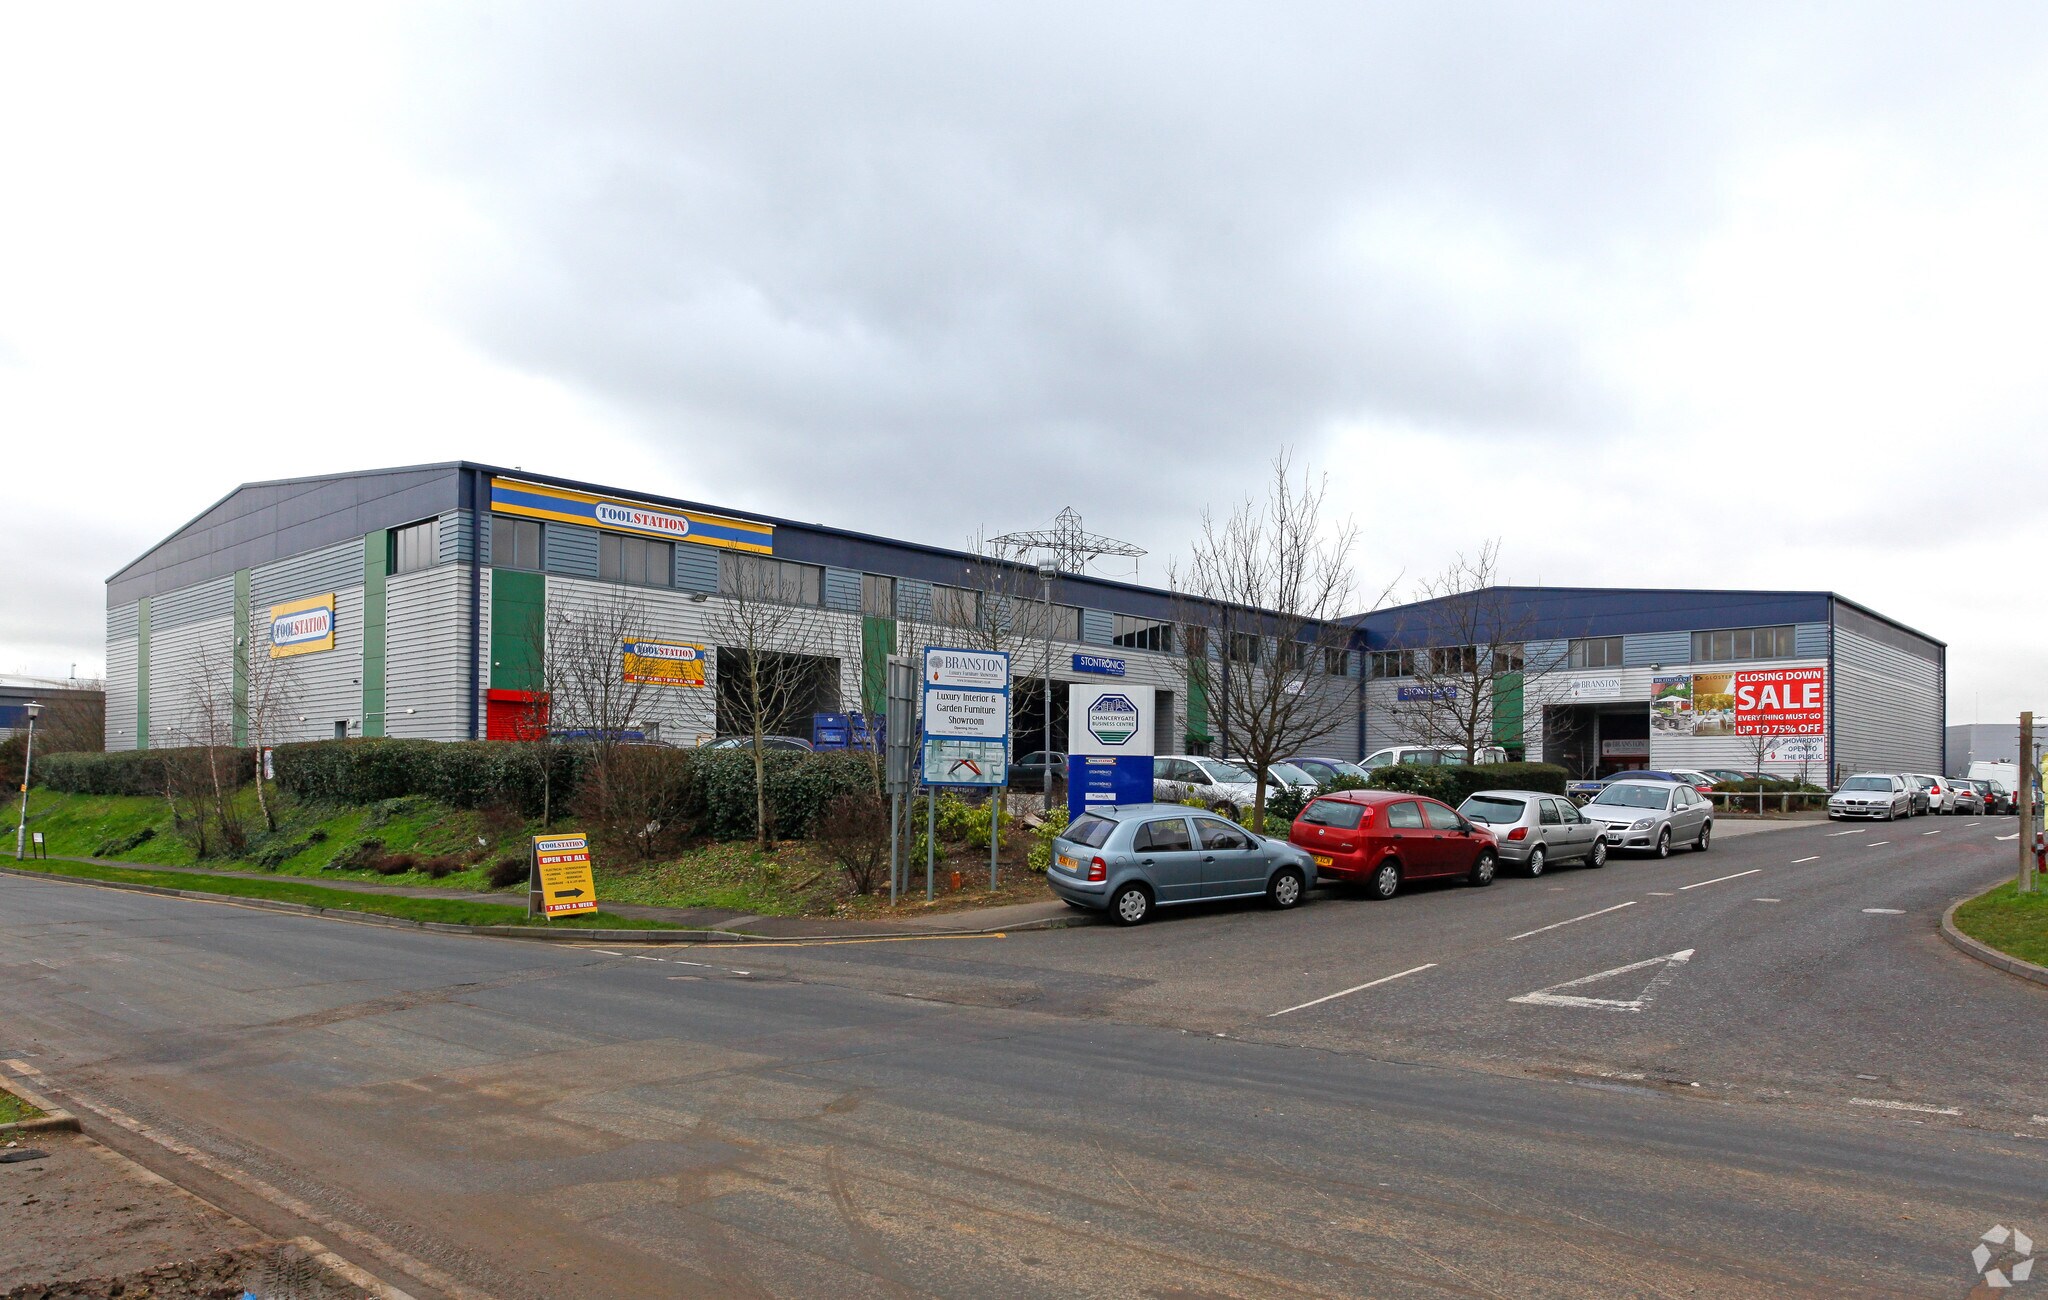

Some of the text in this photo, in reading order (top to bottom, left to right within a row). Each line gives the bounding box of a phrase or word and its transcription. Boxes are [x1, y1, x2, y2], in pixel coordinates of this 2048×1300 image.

[600, 507, 685, 532] TOOLSTATION
[275, 615, 327, 638] TOOLSTATION
[636, 642, 694, 658] TOOLSTATION
[945, 656, 1002, 671] BRANSTON
[1080, 657, 1124, 670] STONTRONICS
[1738, 671, 1820, 682] CLOSING DOWN
[1582, 680, 1619, 688] BRANSTON
[936, 692, 960, 702] Luxury
[963, 693, 989, 702] Interior
[1738, 683, 1820, 710] SALE
[937, 704, 996, 714] Garden Furniture
[949, 716, 984, 725] Showroom
[1738, 726, 1752, 734] UP
[1772, 725, 1796, 733] 75%
[1798, 724, 1820, 733] OFF
[541, 841, 584, 849] TOOLSTATION
[542, 856, 561, 864] OPEN
